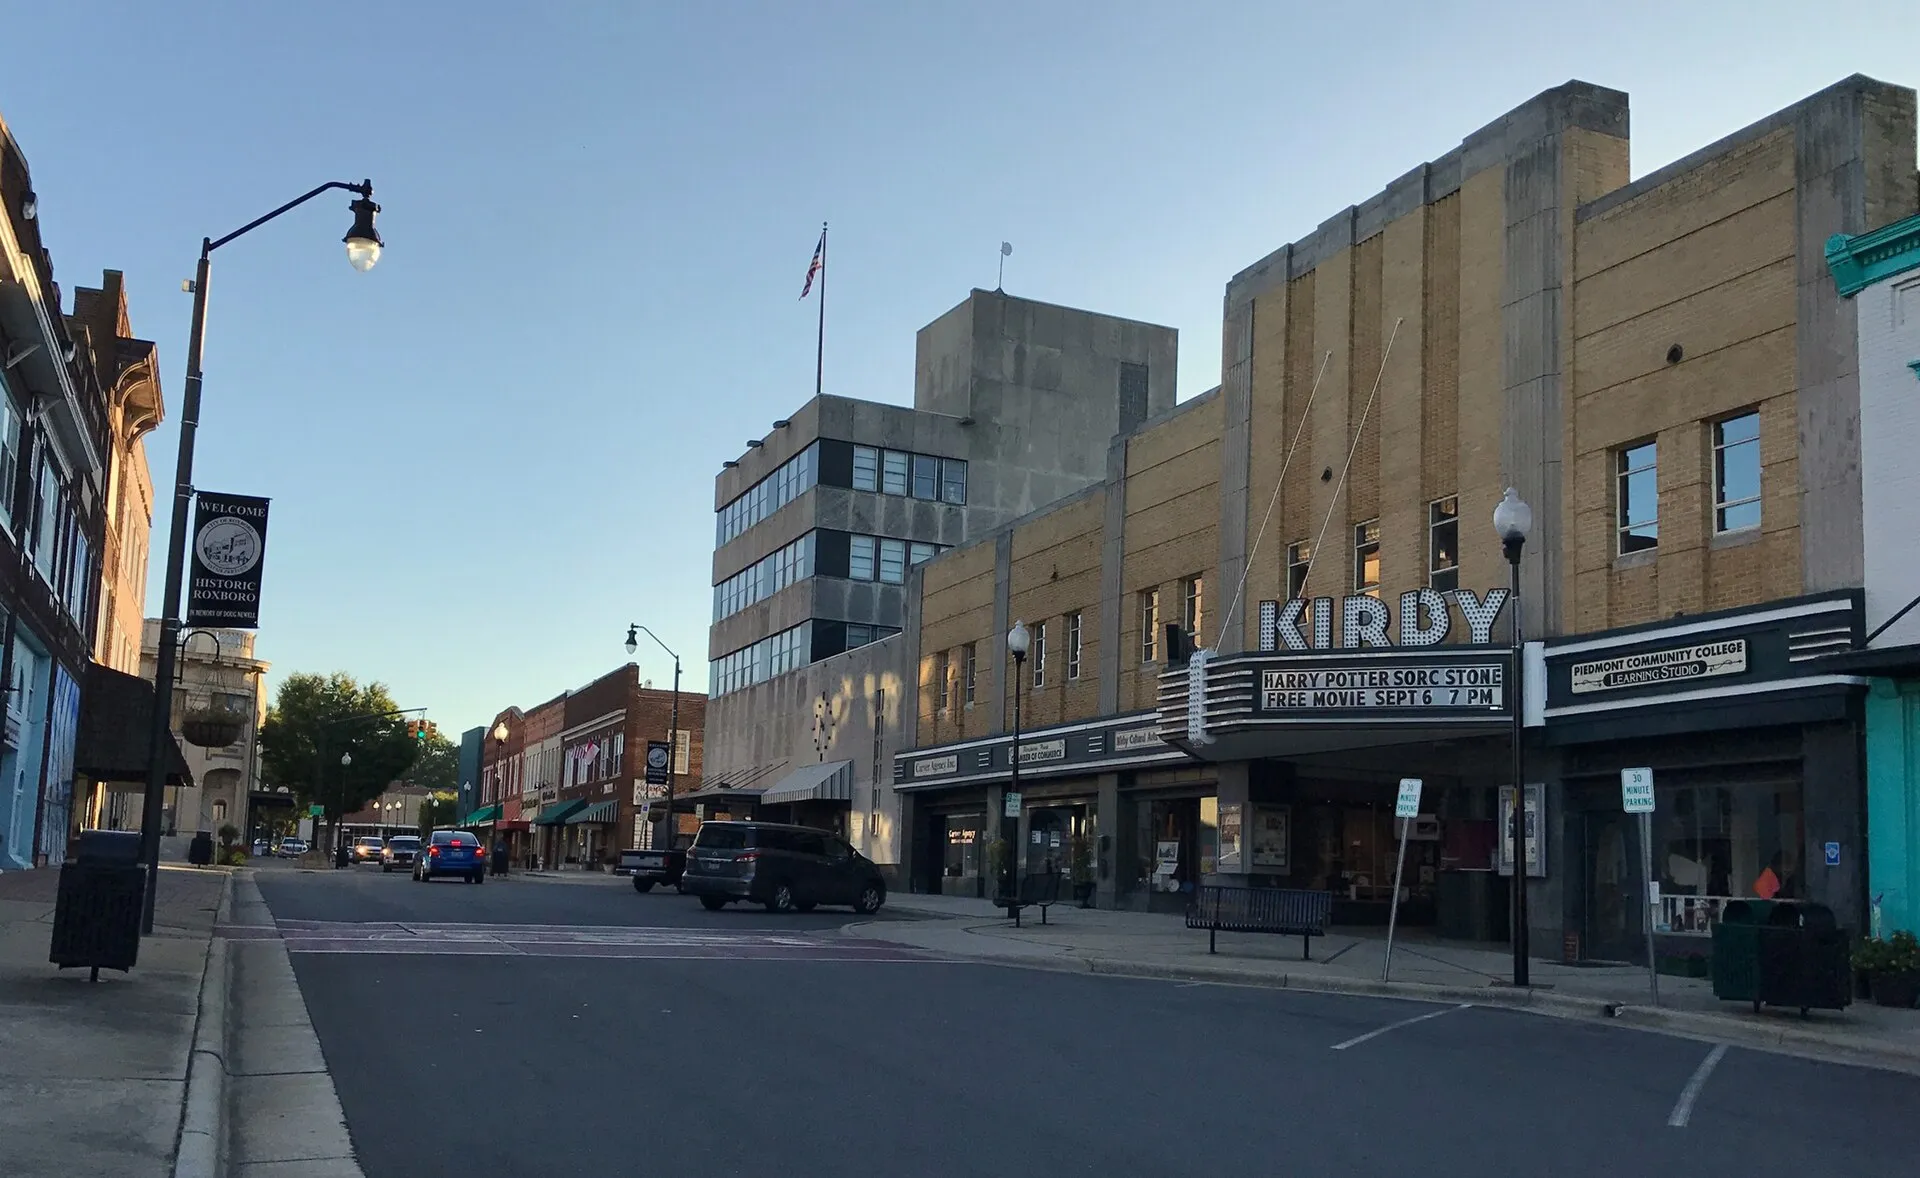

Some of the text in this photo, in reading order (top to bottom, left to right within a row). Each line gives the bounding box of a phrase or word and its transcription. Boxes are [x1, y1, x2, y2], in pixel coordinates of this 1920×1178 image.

[200, 502, 265, 517] WELCOME
[195, 578, 256, 591] HISTORIC
[193, 590, 256, 602] ROXBORO
[196, 609, 215, 617] MEMORY
[1259, 587, 1511, 651] KIRBY
[1574, 641, 1743, 676] PIEDMONT COMMUNITY COLLEGE
[1264, 668, 1502, 688] HARRY POTTER SORC STONE
[1609, 663, 1700, 686] LEARNING STUDIO
[1267, 688, 1493, 707] FREE MOVIE SEPT 6 7 PM
[1031, 752, 1037, 760] OF
[1038, 749, 1062, 760] COMMERCE
[1632, 773, 1642, 783] 30
[1626, 785, 1650, 795] MINUTE
[1400, 794, 1417, 803] MINUTE
[1625, 797, 1652, 806] PARKING
[1397, 804, 1417, 812] PARKING
